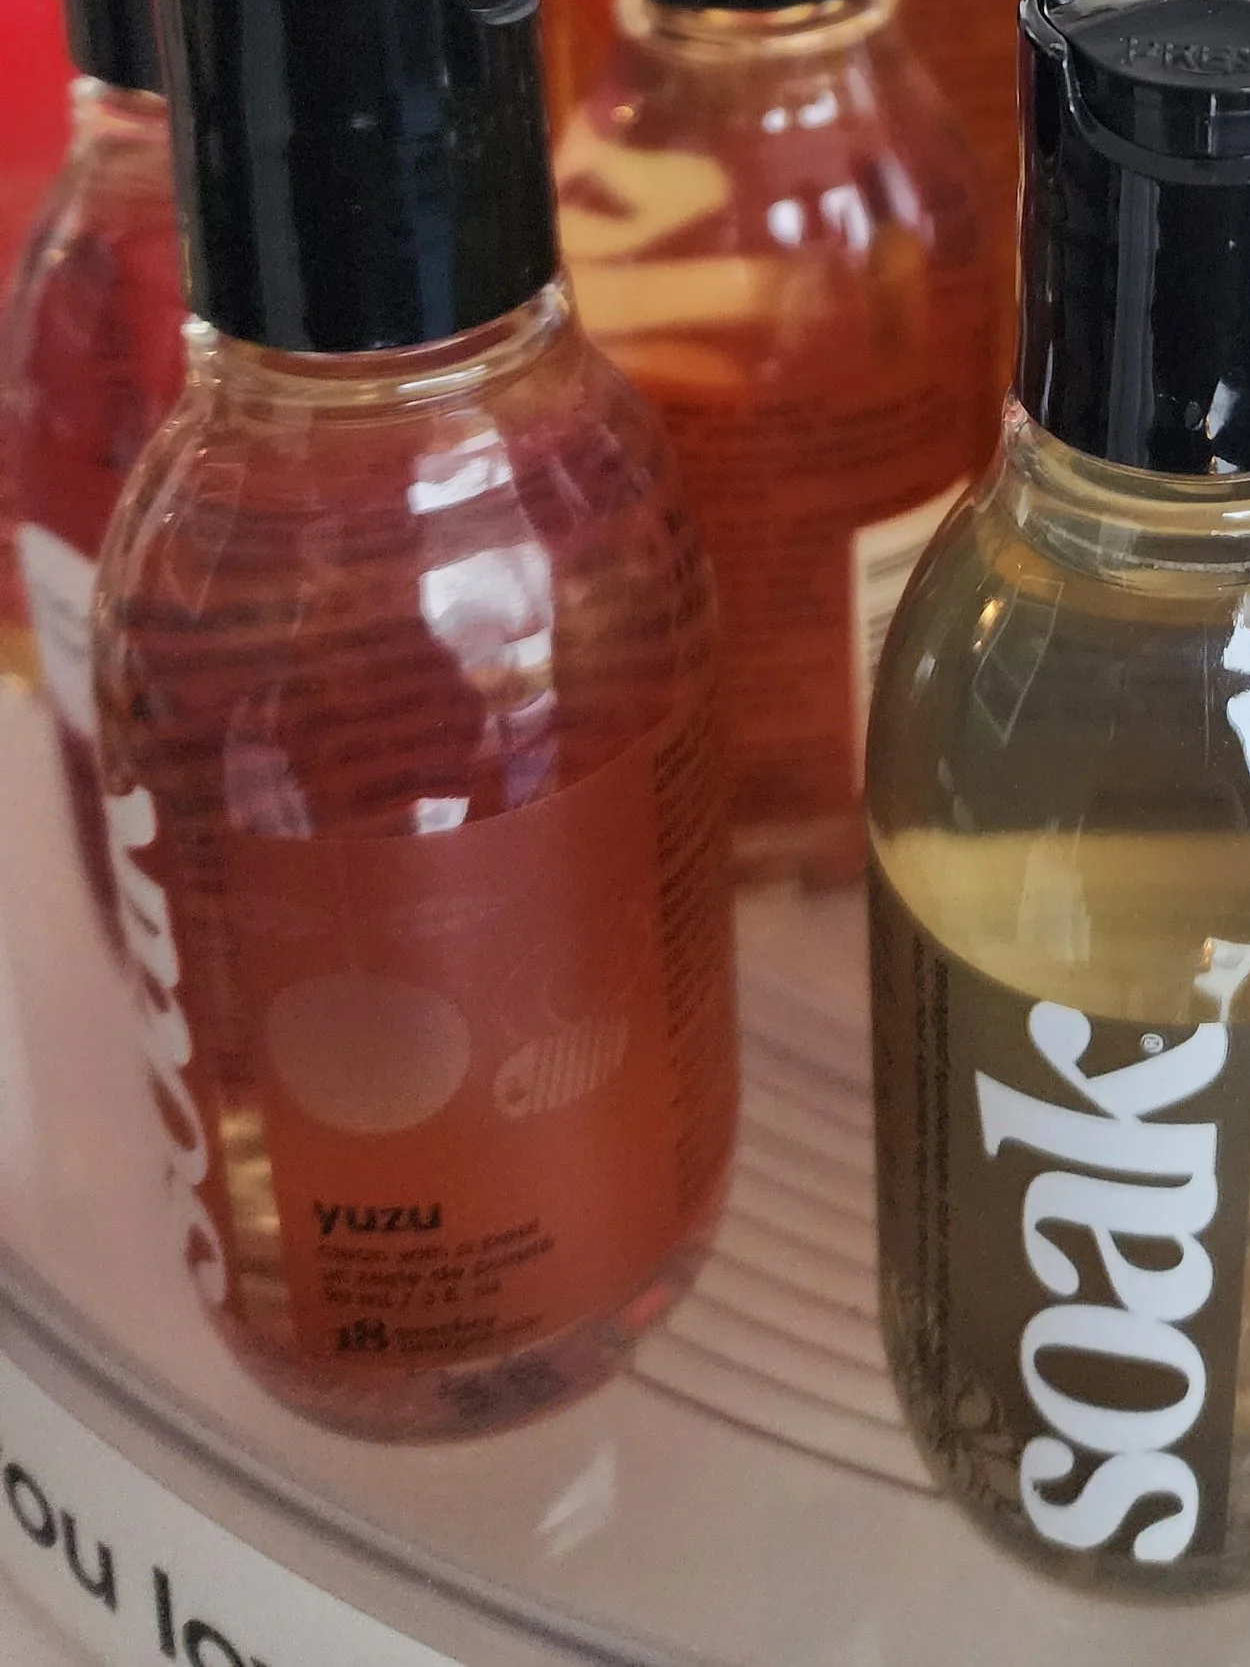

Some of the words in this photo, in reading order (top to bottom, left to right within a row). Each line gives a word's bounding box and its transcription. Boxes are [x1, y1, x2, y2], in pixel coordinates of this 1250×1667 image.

[313, 1200, 442, 1235] yuzu
[0, 1439, 118, 1615] ou
[152, 1563, 275, 1667] lo
